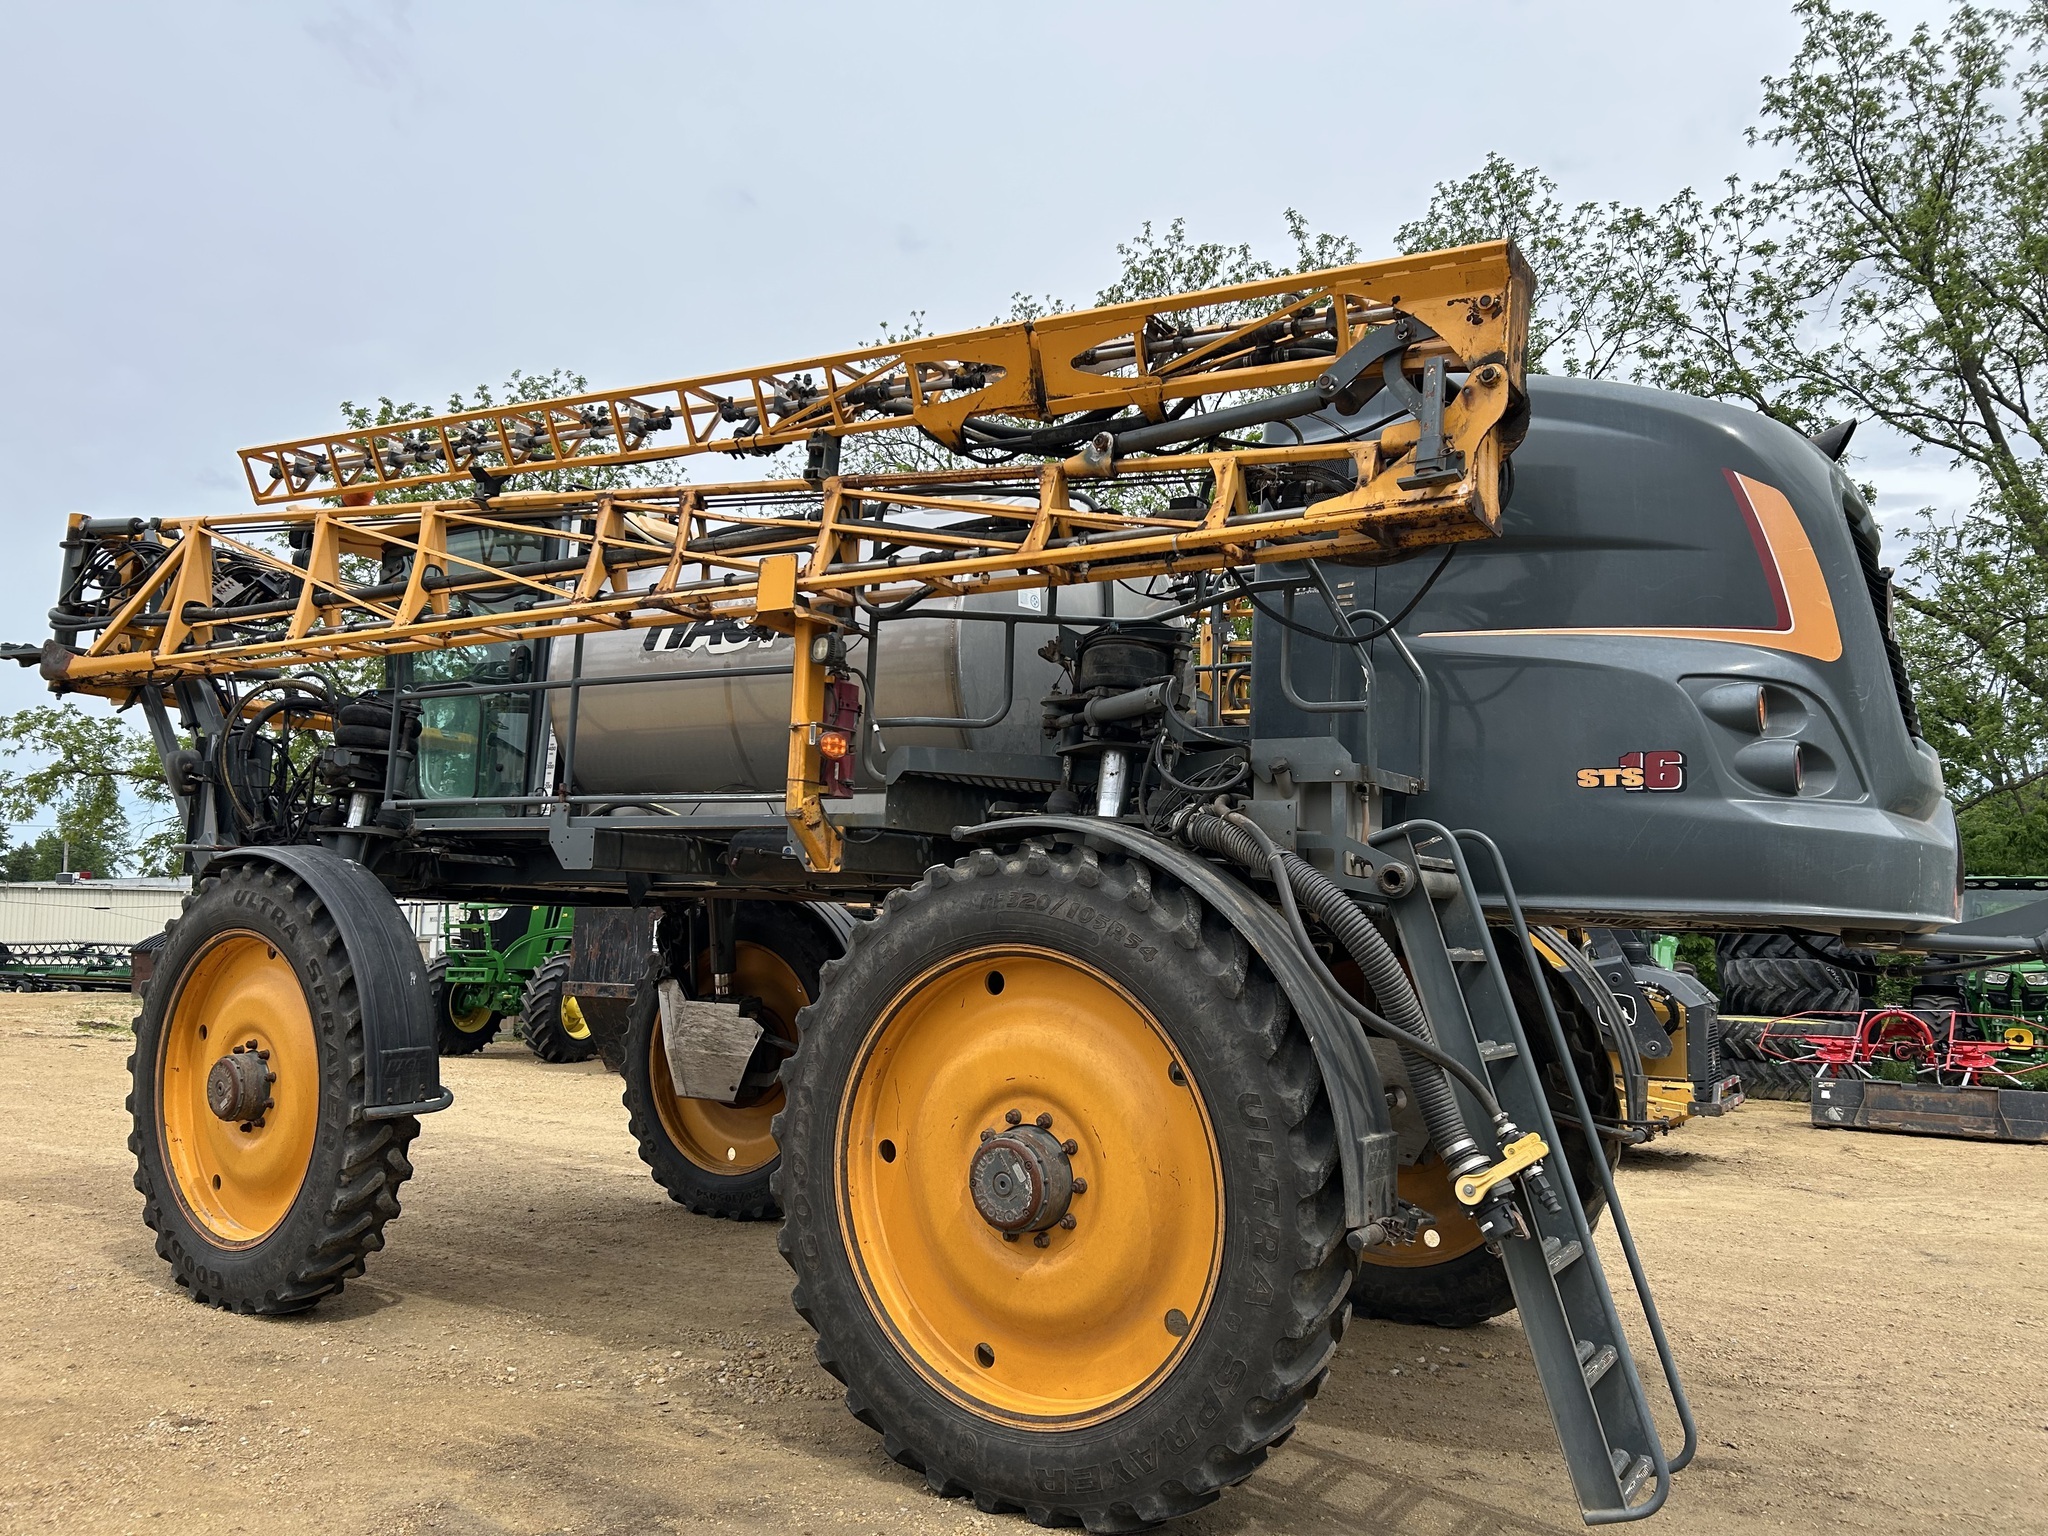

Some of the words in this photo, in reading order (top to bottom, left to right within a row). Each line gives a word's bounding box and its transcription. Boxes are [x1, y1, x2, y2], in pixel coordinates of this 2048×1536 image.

[1577, 768, 1644, 788] STS
[1619, 750, 1687, 793] 16
[233, 889, 301, 943] ULTRA
[305, 957, 342, 1151] SPRAYER
[1236, 1091, 1282, 1307] ULTRA
[1034, 1351, 1248, 1495] SPRAYER
